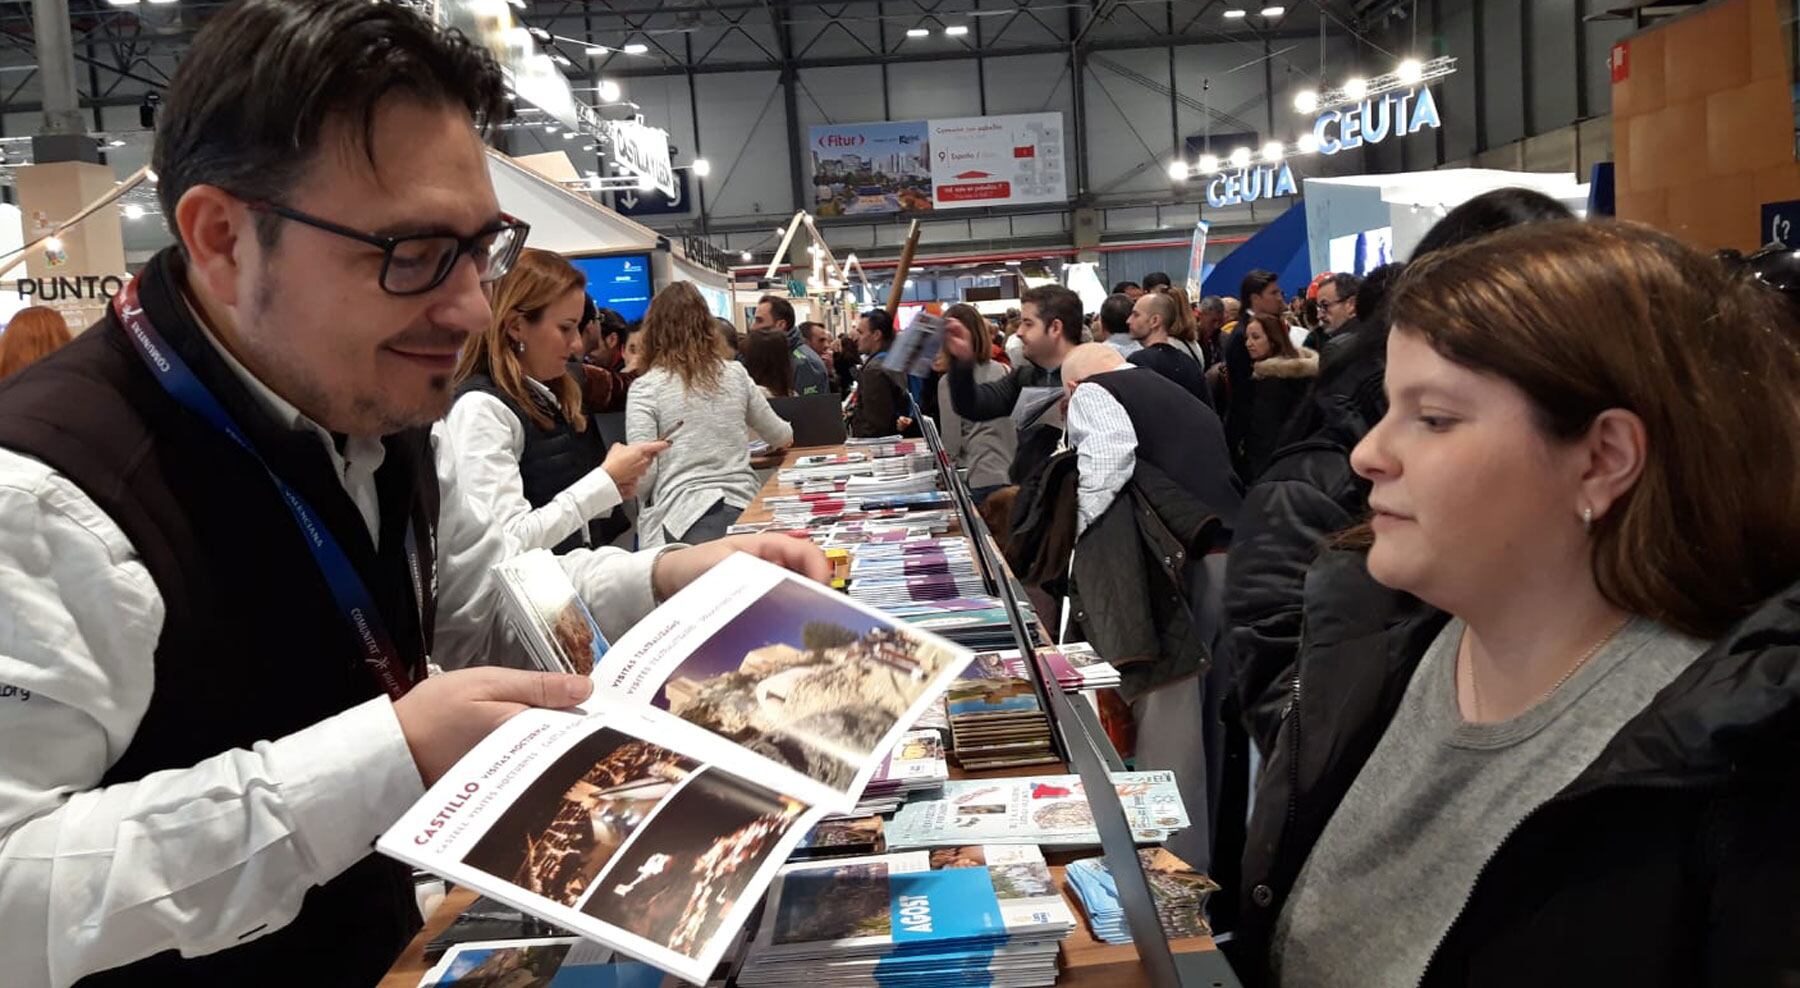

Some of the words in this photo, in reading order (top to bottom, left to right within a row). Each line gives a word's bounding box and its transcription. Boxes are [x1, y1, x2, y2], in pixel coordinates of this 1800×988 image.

[827, 133, 857, 147] Fitur
[1313, 83, 1441, 155] CEUTA
[1206, 159, 1298, 208] CEUTA
[16, 275, 123, 302] PUNTO
[131, 321, 171, 373] COMUNITAT
[351, 607, 380, 655] COMUNITAT
[612, 659, 637, 688] VISITAS
[413, 781, 480, 846] CASTILLO
[481, 755, 511, 779] VISITAS
[510, 723, 551, 755] NOCTURNAS
[436, 821, 470, 854] CASTELL
[898, 894, 933, 933] AGOST
